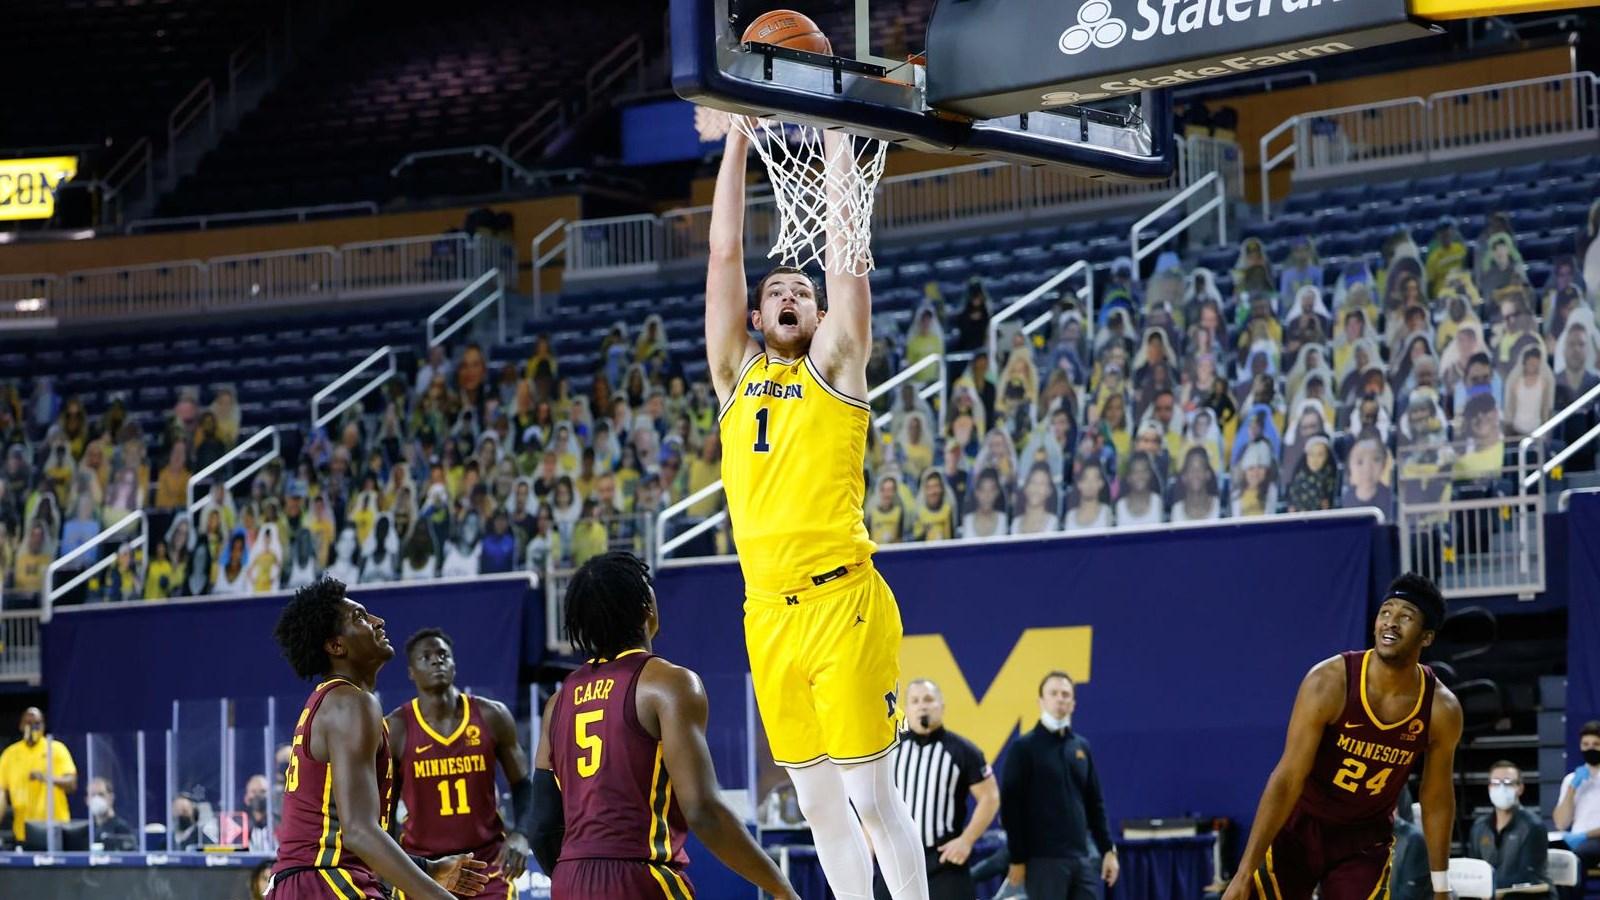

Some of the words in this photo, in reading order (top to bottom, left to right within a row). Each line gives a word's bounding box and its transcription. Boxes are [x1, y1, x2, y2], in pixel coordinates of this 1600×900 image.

[753, 407, 770, 453] 1
[574, 678, 615, 706] CARR
[575, 709, 604, 779] 5
[1336, 733, 1416, 766] MINNESOTA
[413, 754, 487, 779] MINNESOTA
[1332, 757, 1394, 797] 24
[437, 778, 471, 816] 11
